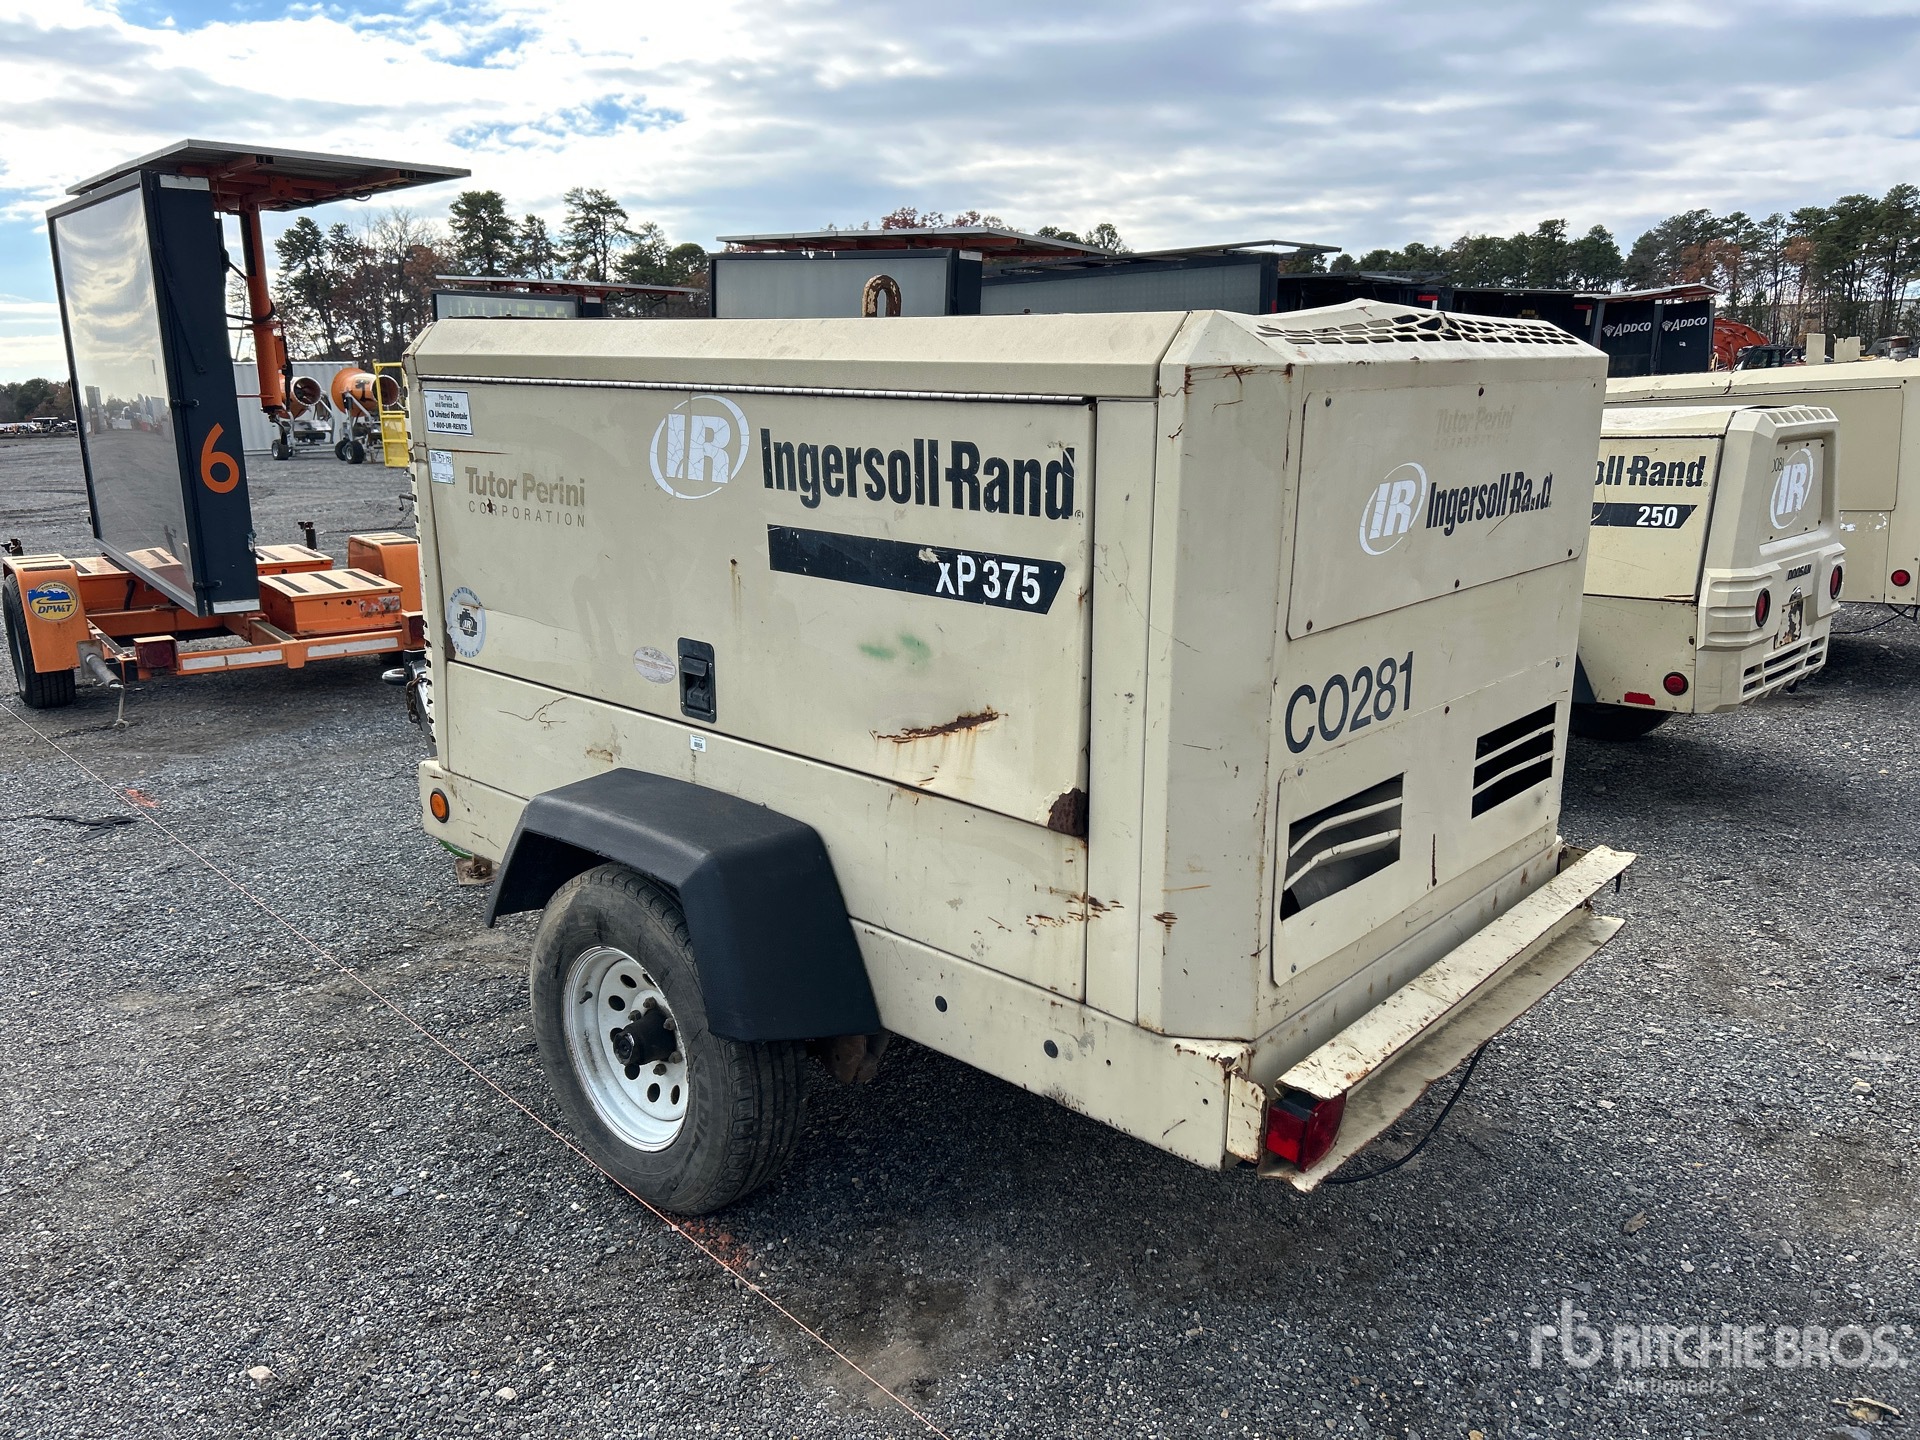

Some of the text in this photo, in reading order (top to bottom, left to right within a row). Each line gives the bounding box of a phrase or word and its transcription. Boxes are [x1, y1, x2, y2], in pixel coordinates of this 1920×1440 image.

[1613, 322, 1651, 337] ADDCO
[1670, 317, 1708, 332] ADDCO
[435, 410, 468, 420] United Rentals
[201, 422, 240, 494] 6
[464, 466, 585, 507] Tutor Perini
[468, 500, 585, 528] CORPORATION
[1636, 505, 1678, 527] 250
[982, 559, 1041, 605] 375
[1786, 563, 1812, 581] DOOSAN
